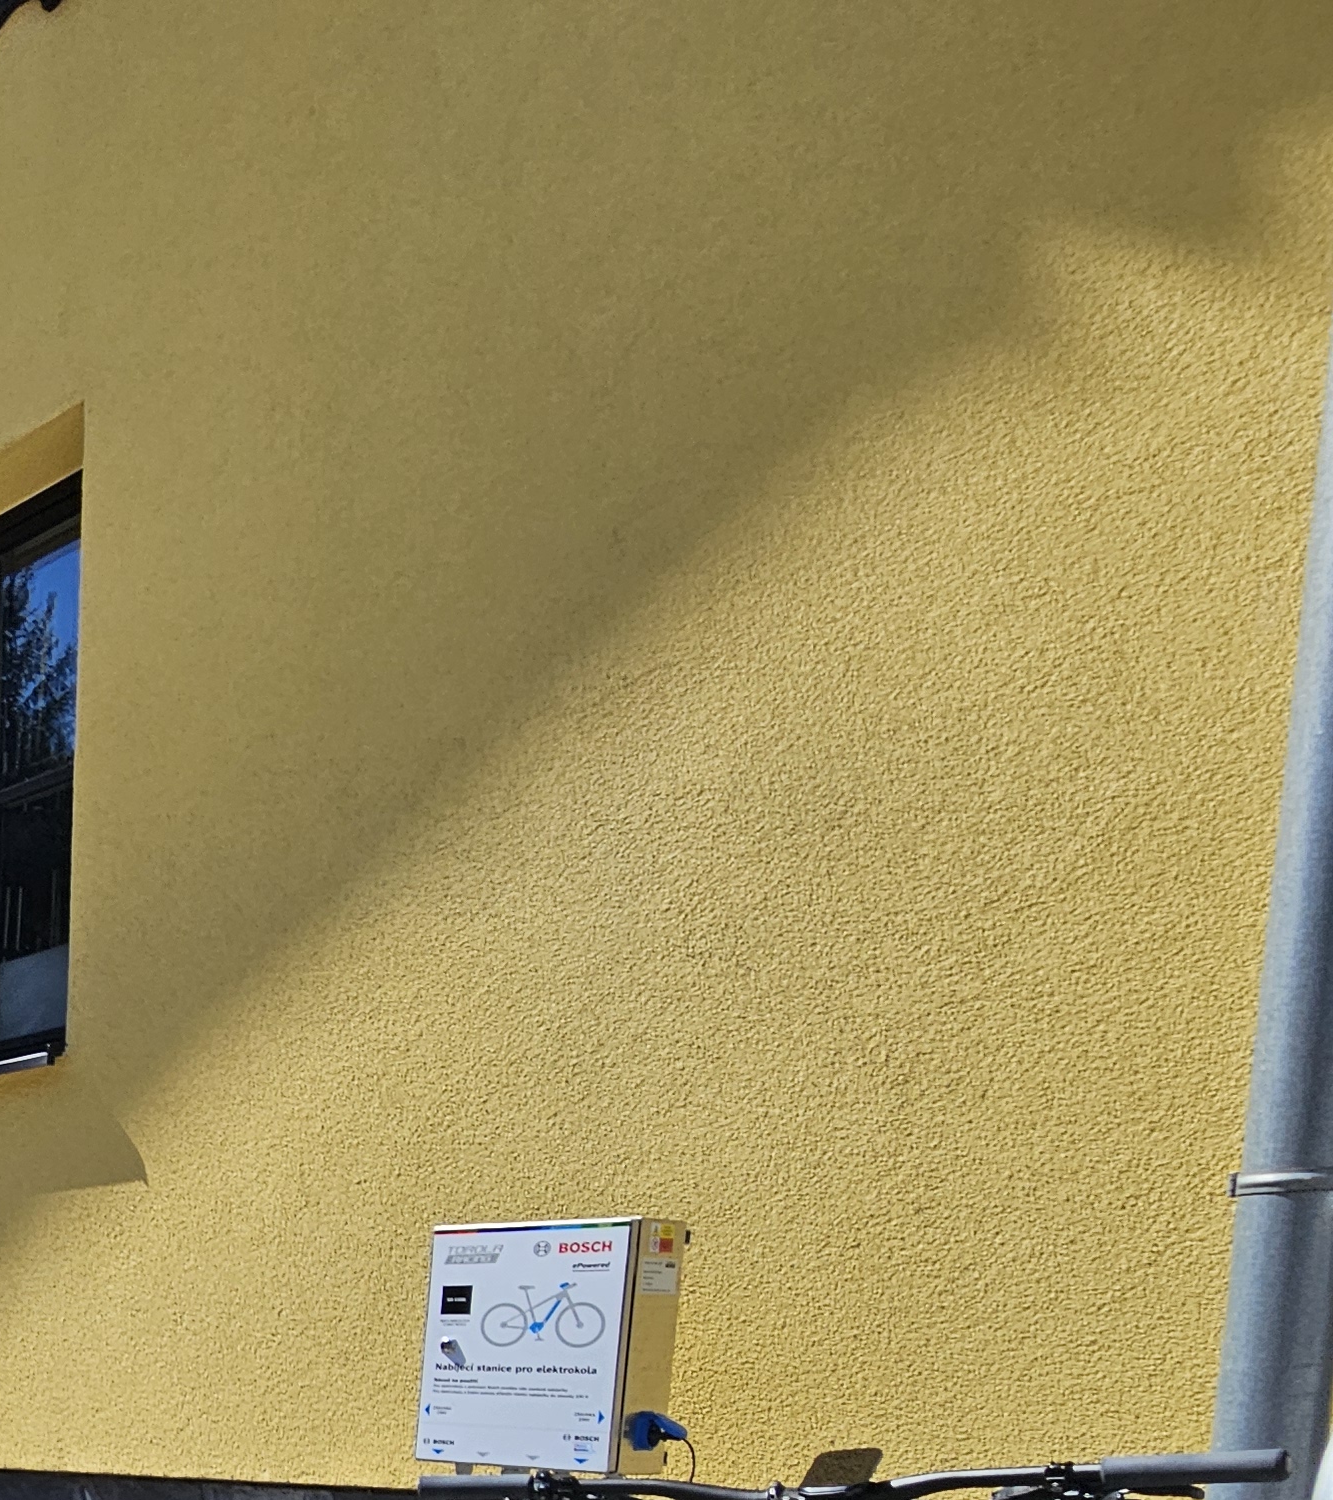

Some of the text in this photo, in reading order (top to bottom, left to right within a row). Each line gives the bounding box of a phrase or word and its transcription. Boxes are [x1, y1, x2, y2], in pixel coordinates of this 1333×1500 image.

[558, 1241, 613, 1254] BOSCH
[572, 1261, 611, 1270] ePowered
[435, 1362, 598, 1375] Nabíjecí stanice pro elektrokola
[574, 1435, 600, 1443] BOSCH
